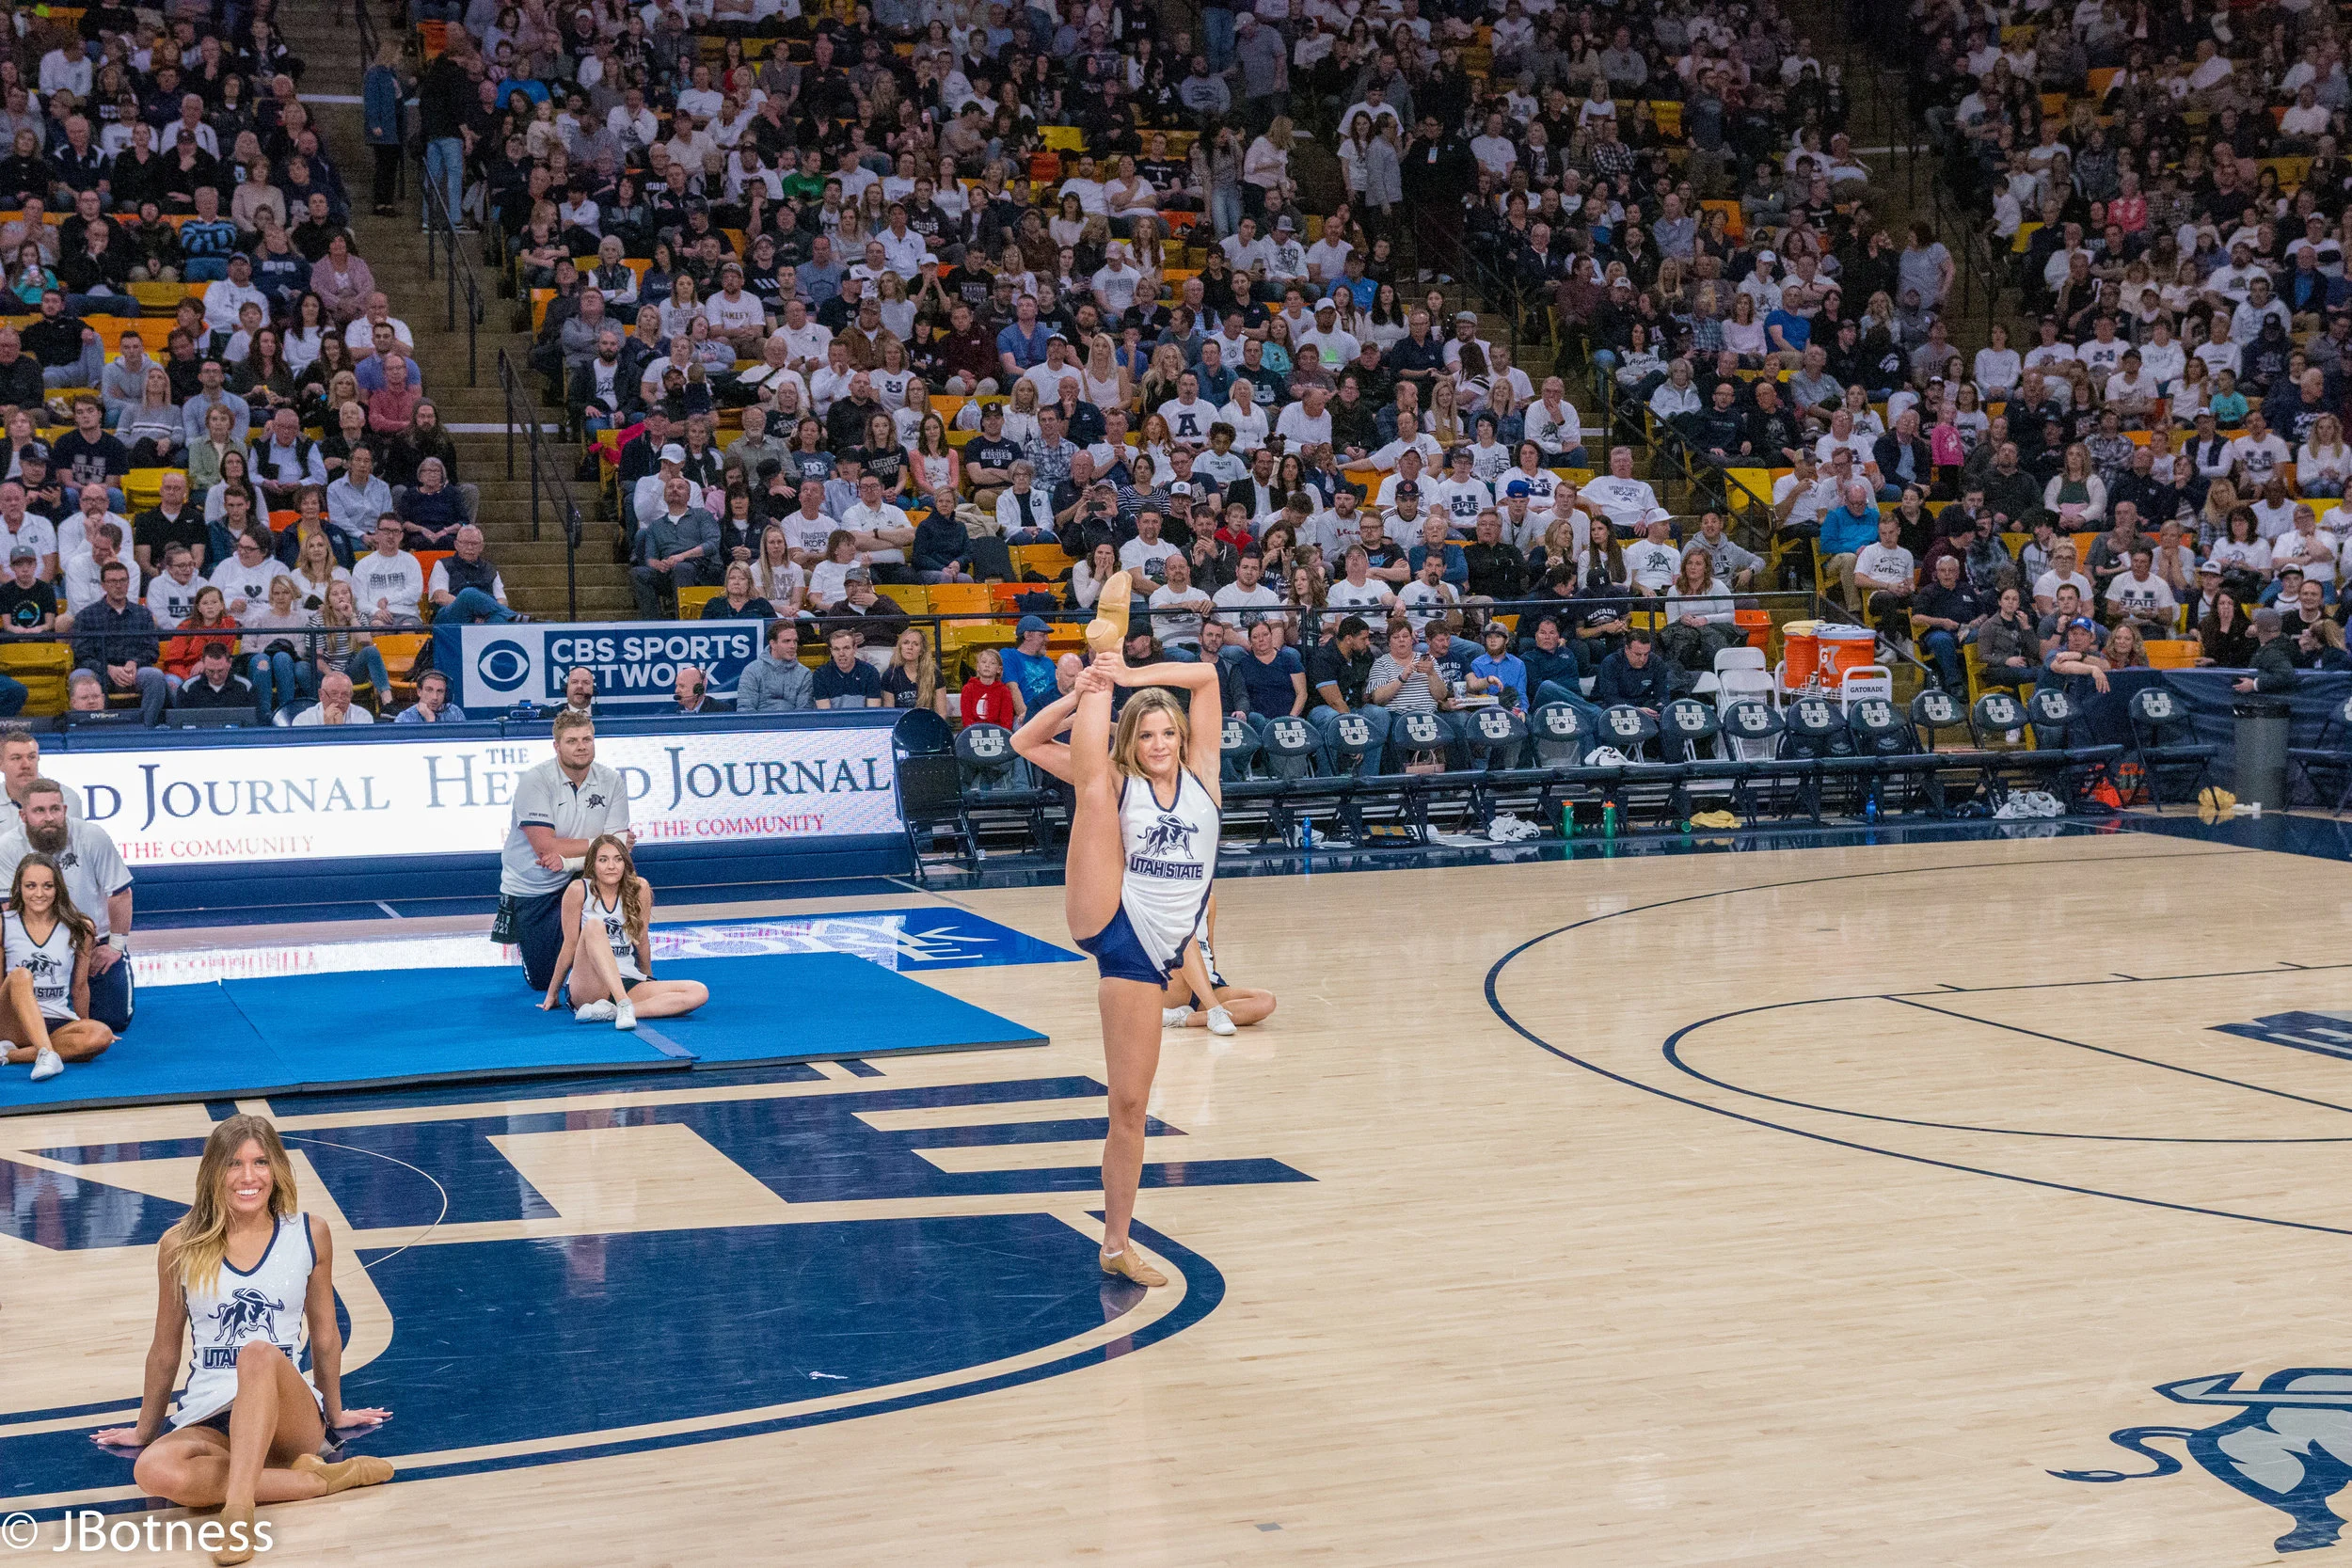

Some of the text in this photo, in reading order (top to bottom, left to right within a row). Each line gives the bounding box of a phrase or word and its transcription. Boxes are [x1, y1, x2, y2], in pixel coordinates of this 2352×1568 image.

[1176, 413, 1201, 436] A
[2120, 599, 2156, 608] STATE
[551, 634, 750, 664] CBS SPORTS
[1924, 704, 1953, 712] STATE
[2042, 700, 2069, 710] STATE
[2142, 700, 2171, 709] STATE
[1986, 705, 2015, 714] STATE
[1675, 713, 1706, 721] STATE
[1739, 713, 1769, 721] STATE
[1800, 710, 1830, 719] STATE
[1861, 710, 1891, 719] STATE
[1546, 716, 1578, 725] STATE
[1610, 718, 1642, 727] STATE
[1406, 723, 1438, 733] STATE
[1479, 721, 1511, 730] STATE
[1274, 729, 1308, 740] STATE
[1339, 727, 1371, 736] STATE
[969, 736, 1005, 748] STATE
[486, 748, 530, 765] THE
[664, 746, 891, 811] JOURNAL
[138, 764, 390, 832] JOURNAL
[650, 820, 691, 837] THE
[695, 814, 824, 835] COMMUNITY
[119, 835, 314, 860] THE COMMUNITY
[1130, 856, 1204, 880] UTAH STATE
